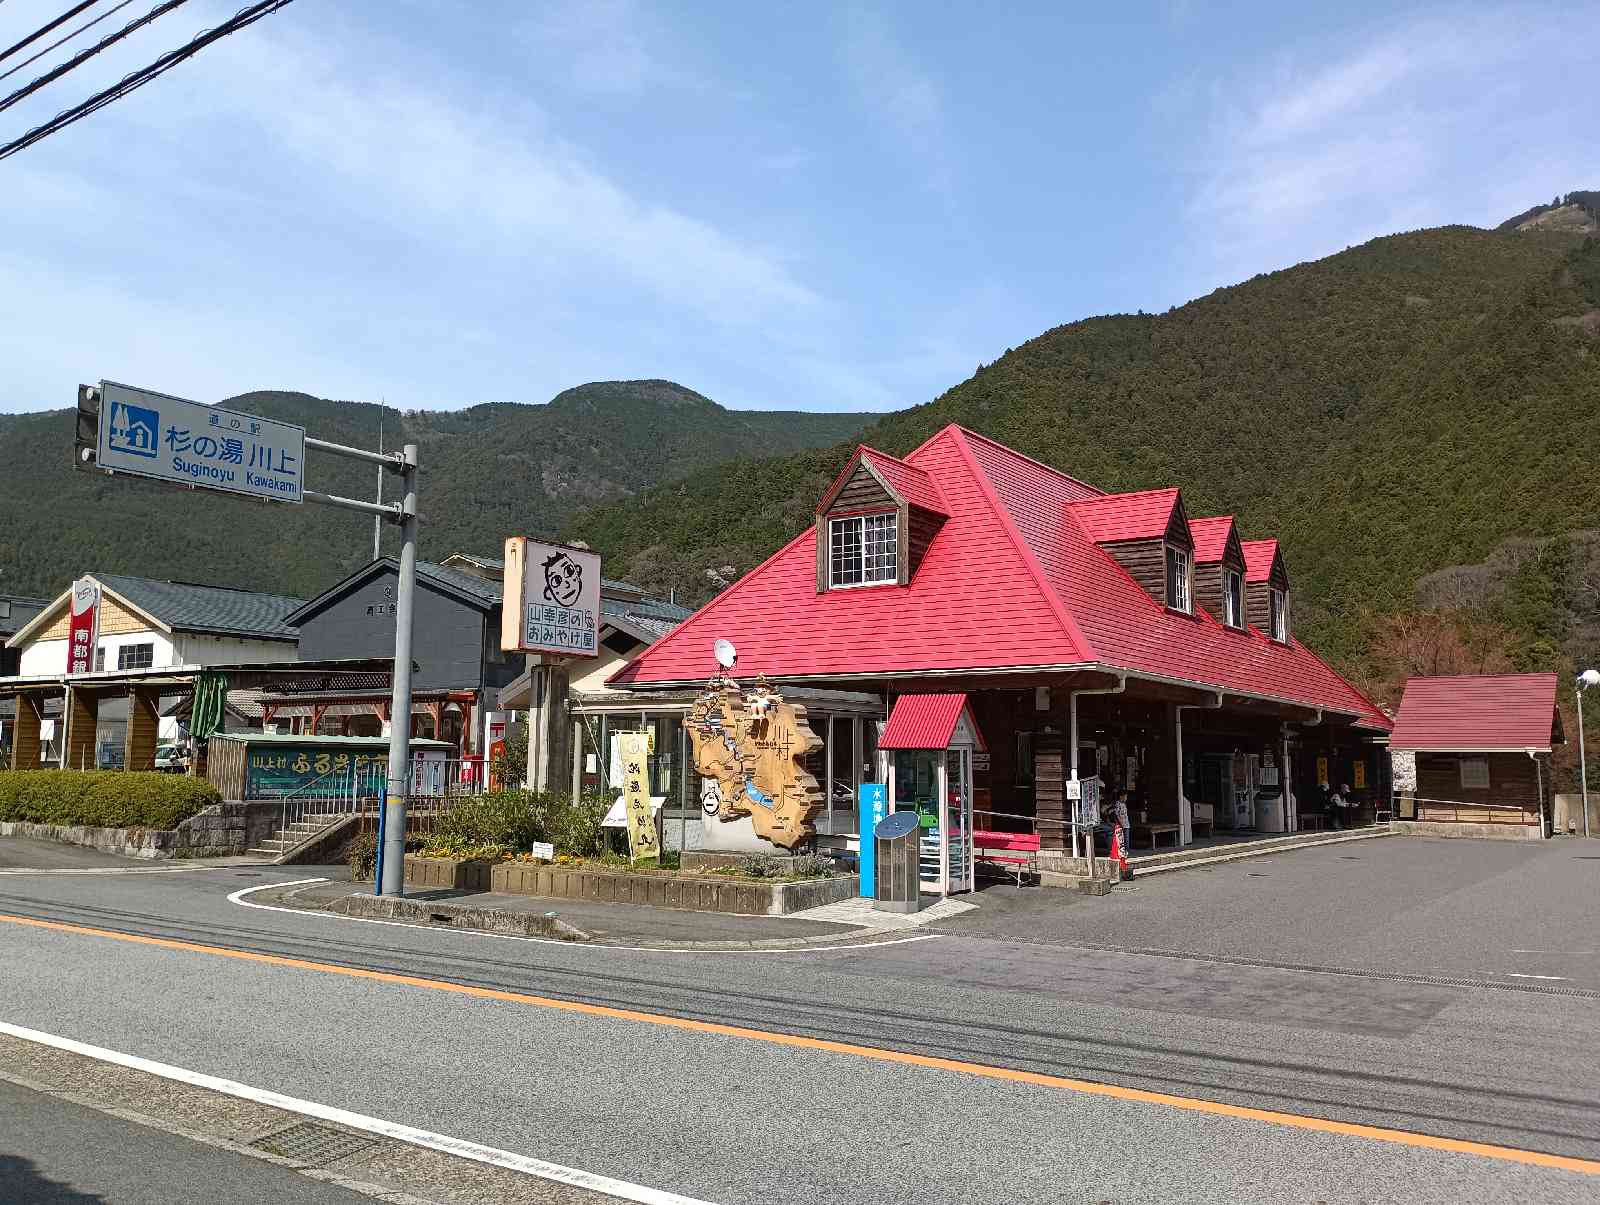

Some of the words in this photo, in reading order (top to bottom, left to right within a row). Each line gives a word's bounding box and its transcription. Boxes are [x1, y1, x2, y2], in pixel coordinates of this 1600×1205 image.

[209, 414, 262, 434] 道の駅
[172, 456, 235, 482] Suginoyu
[246, 472, 297, 493] Kawakami
[530, 607, 581, 627] 山幸彦の
[772, 724, 796, 761] 川上村
